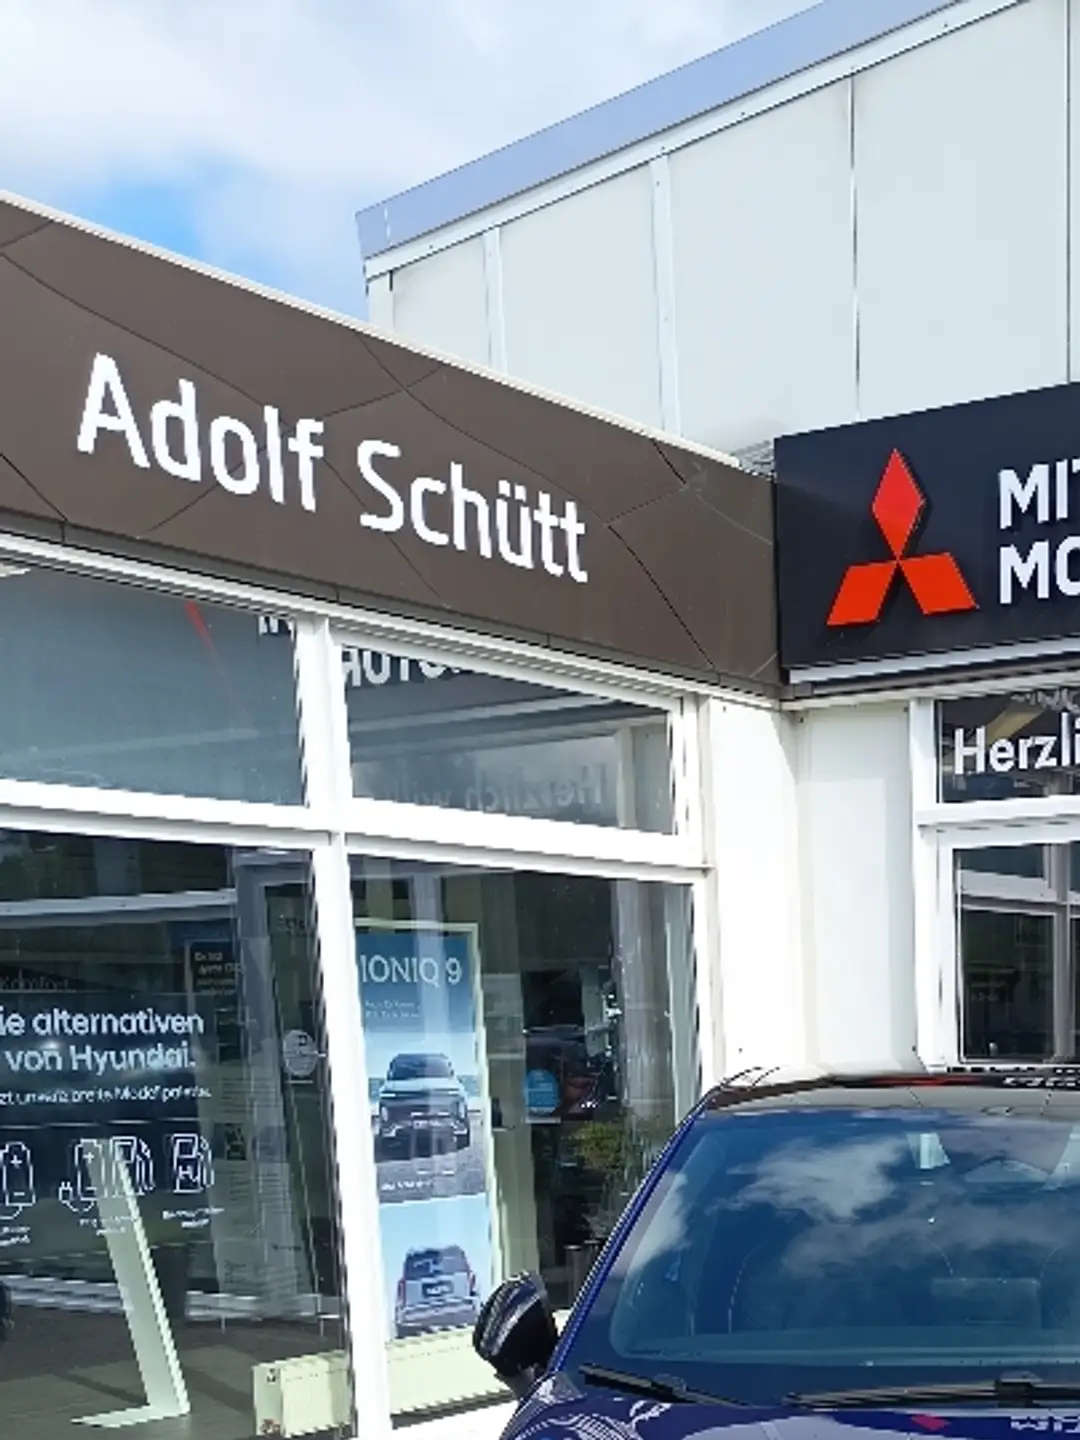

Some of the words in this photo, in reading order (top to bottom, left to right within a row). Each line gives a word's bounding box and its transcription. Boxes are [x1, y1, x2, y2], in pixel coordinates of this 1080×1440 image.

[77, 353, 325, 512] Adolf
[358, 440, 589, 583] Schütt
[360, 954, 440, 988] IONIQ
[446, 957, 462, 985] 9
[32, 1008, 204, 1036] alternativen
[5, 1049, 63, 1071] von
[69, 1041, 196, 1076] Hyundai.
